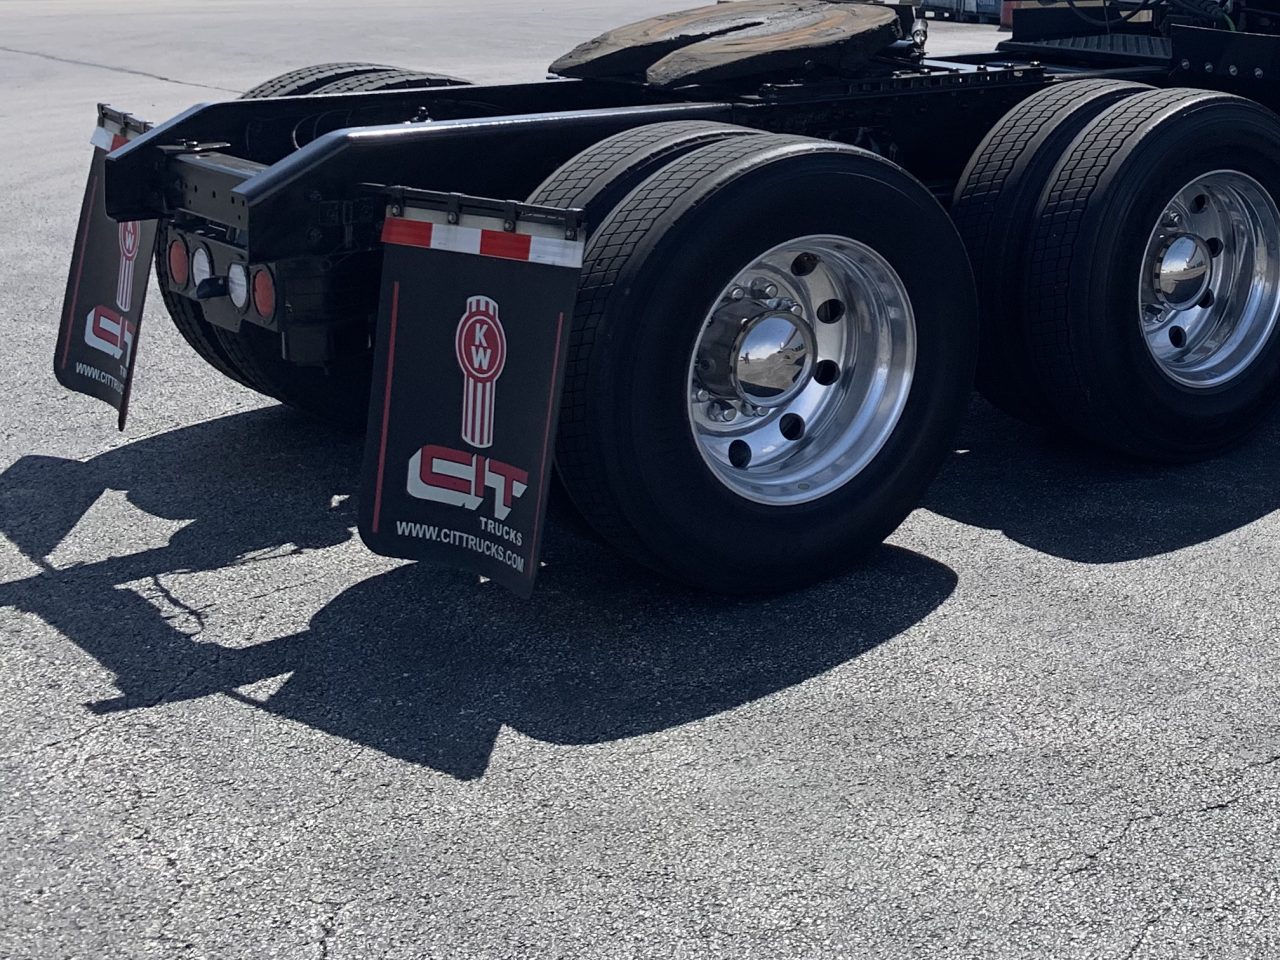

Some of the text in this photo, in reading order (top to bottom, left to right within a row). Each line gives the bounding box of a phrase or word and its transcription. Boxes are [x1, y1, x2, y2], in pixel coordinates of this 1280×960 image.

[411, 444, 529, 514] CIT
[396, 520, 525, 573] WWW.CITTRUCKS.COM
[479, 516, 523, 546] TRUCKS
